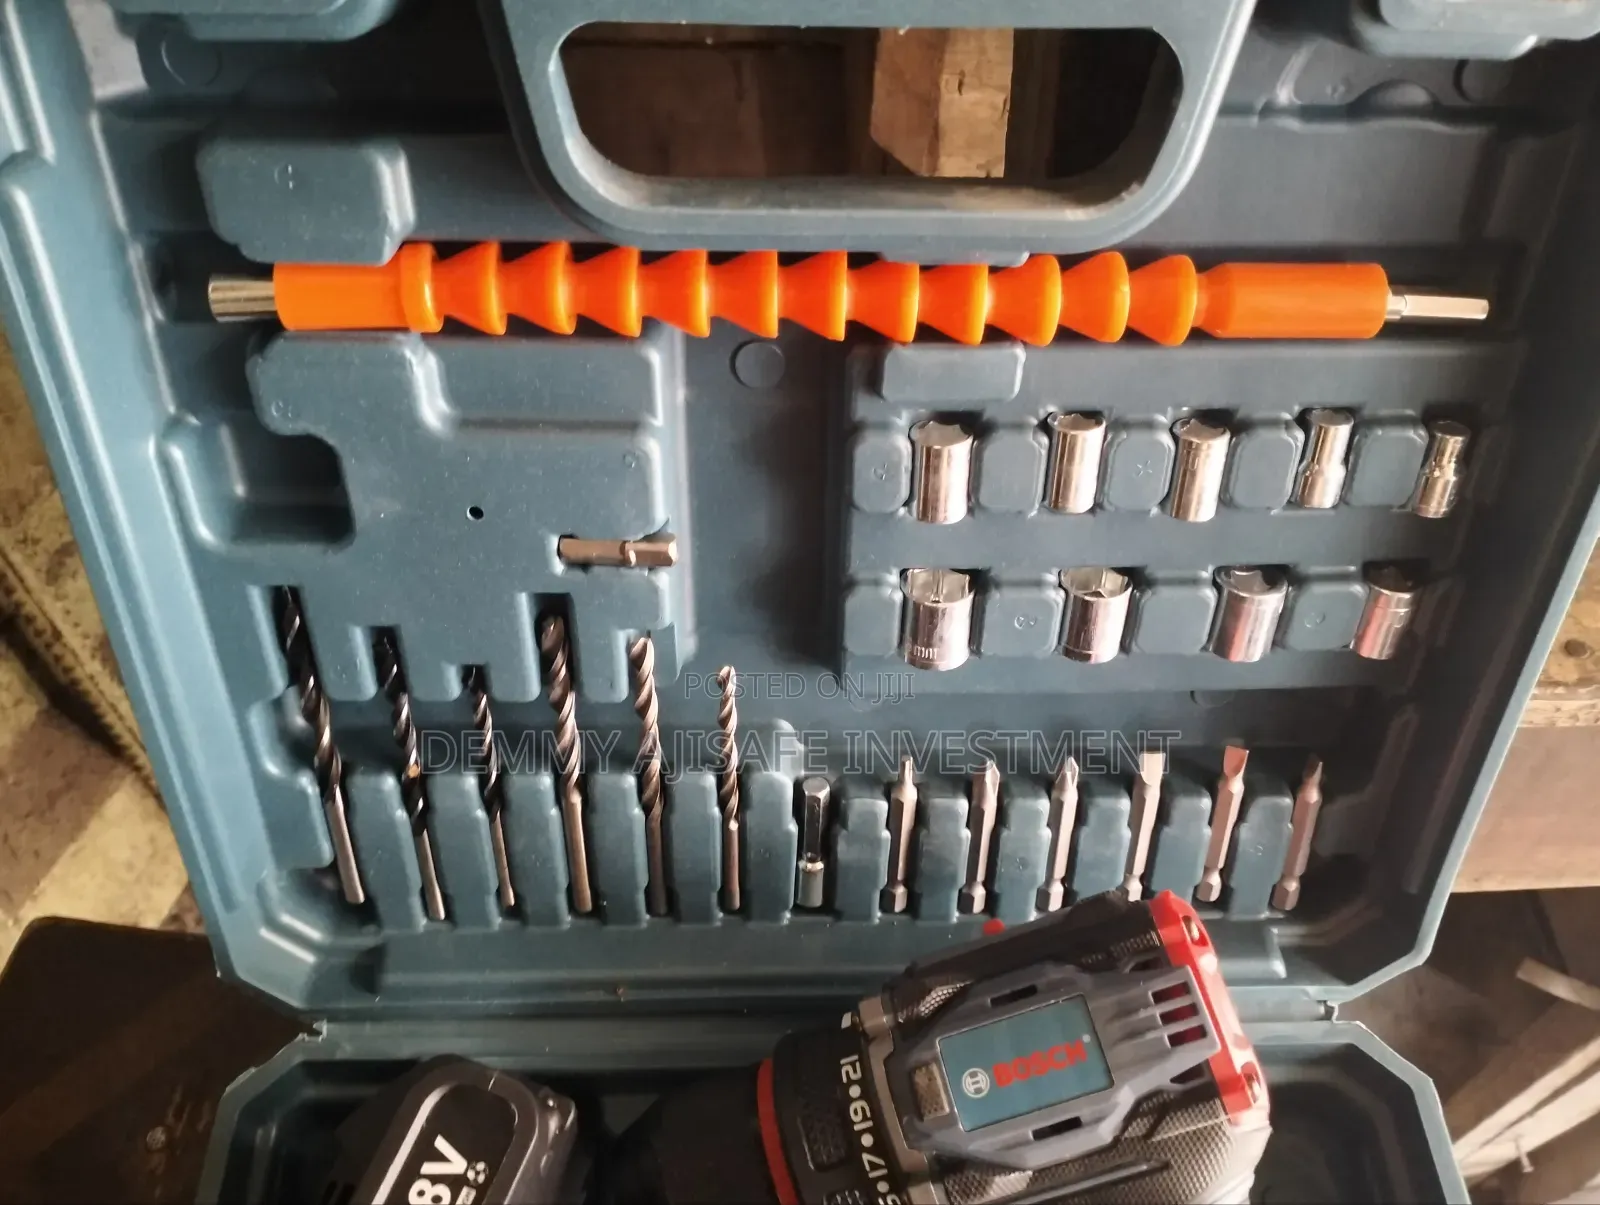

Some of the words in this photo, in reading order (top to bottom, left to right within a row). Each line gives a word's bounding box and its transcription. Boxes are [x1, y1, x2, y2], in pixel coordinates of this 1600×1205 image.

[840, 1054, 862, 1084] 21
[992, 1039, 1087, 1088] BOSCH
[849, 1100, 874, 1132] 19
[861, 1151, 888, 1179] 17
